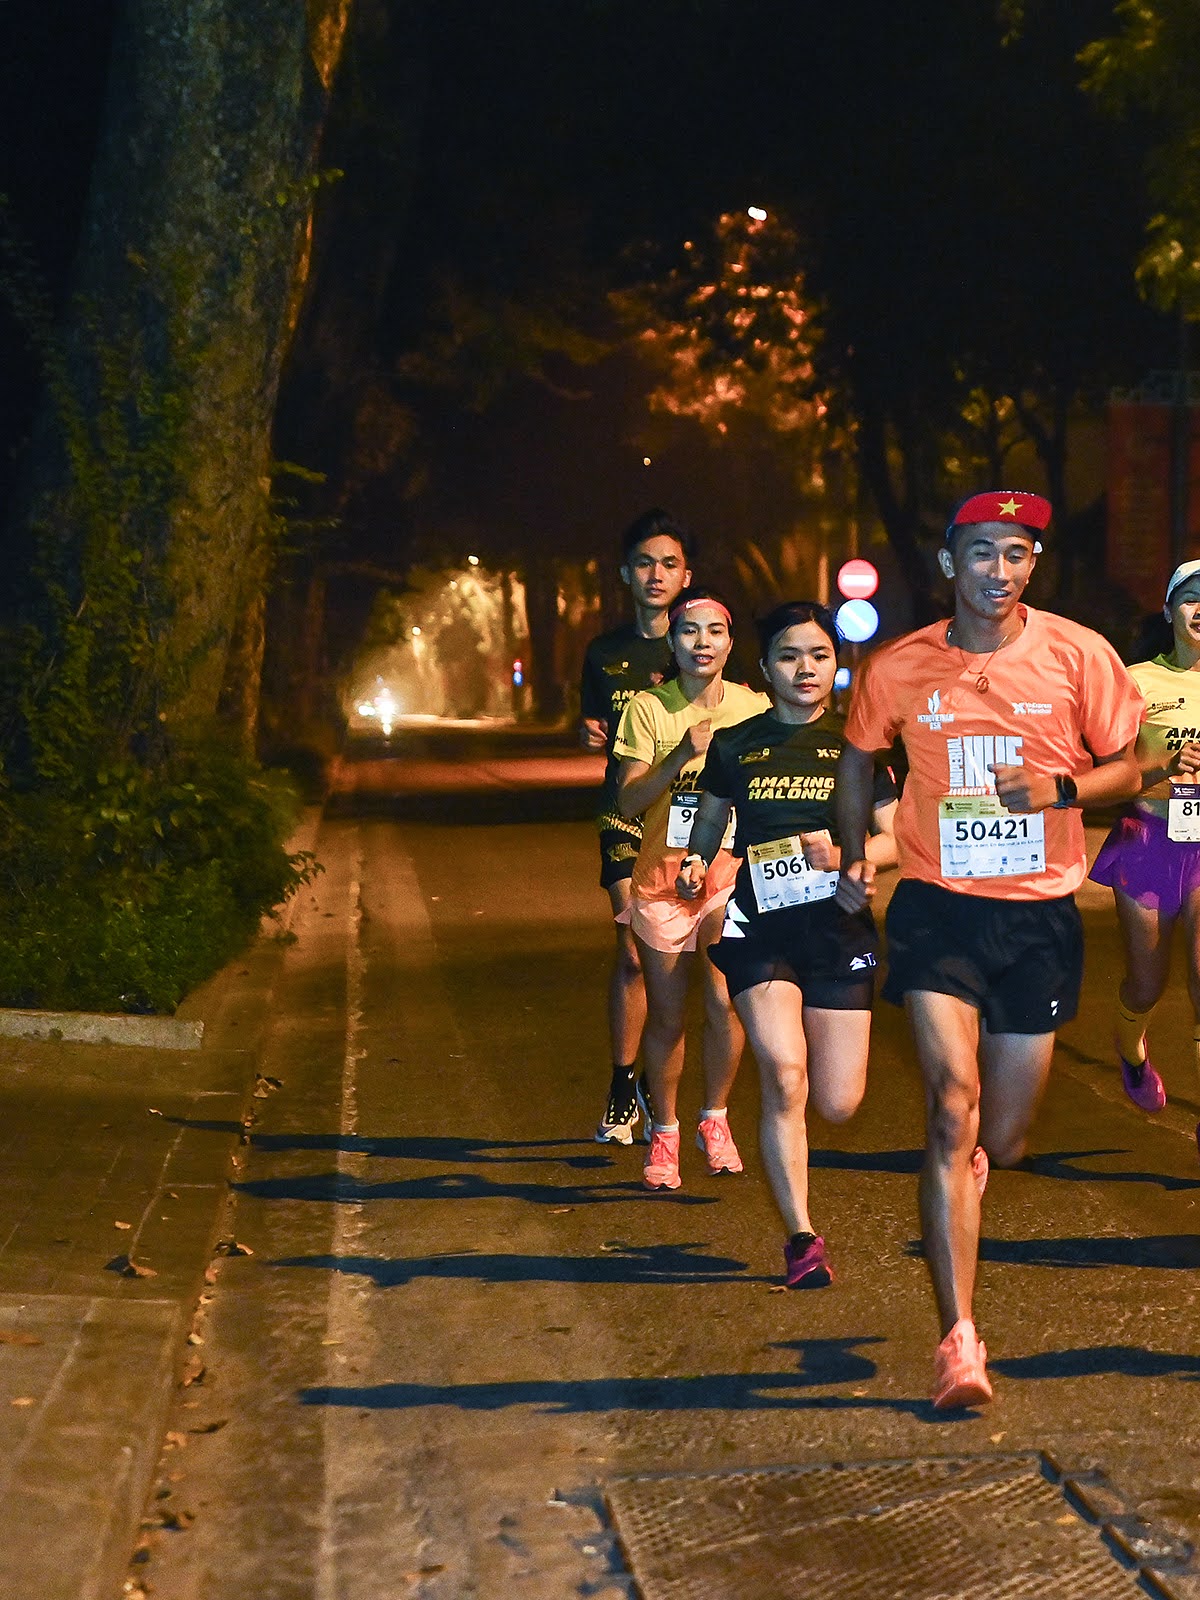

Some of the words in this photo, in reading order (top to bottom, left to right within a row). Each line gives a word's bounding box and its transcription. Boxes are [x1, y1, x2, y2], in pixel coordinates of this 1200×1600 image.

[748, 776, 835, 789] AMAZING
[748, 788, 831, 800] HALONG
[955, 818, 1028, 842] 50421
[763, 856, 812, 880] 5061
